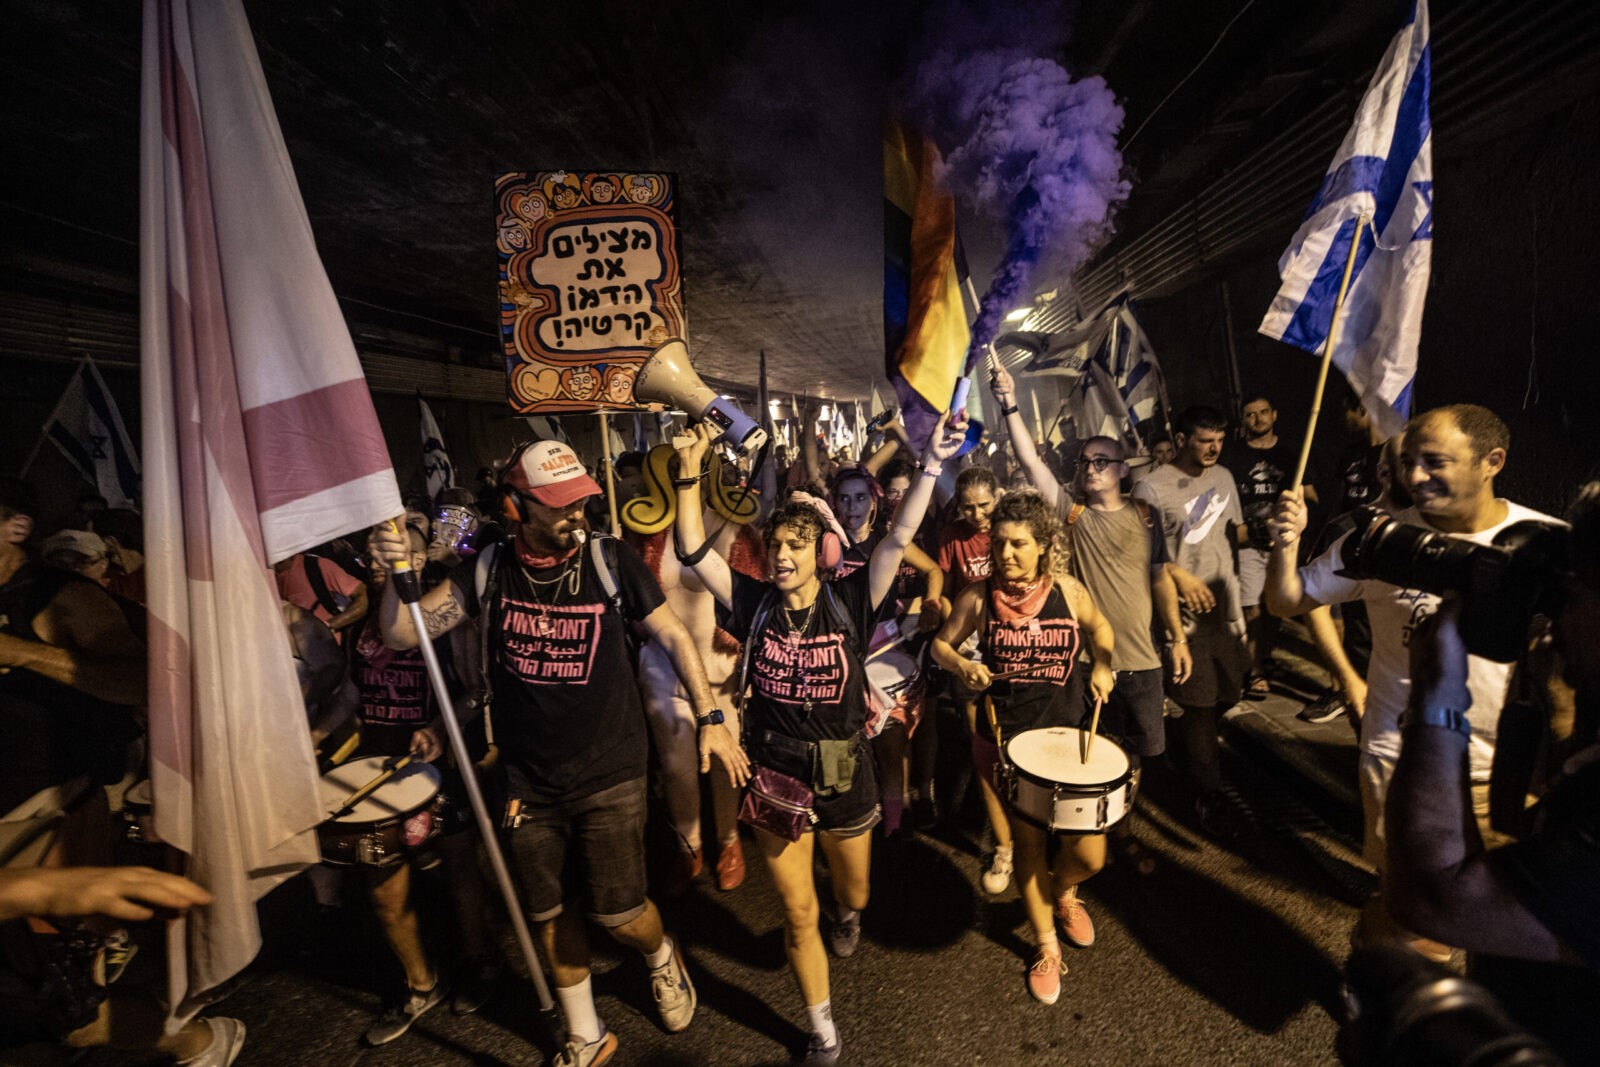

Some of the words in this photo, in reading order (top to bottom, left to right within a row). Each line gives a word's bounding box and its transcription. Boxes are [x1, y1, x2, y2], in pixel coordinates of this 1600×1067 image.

[552, 226, 652, 259] מצילים
[577, 257, 626, 281] את
[552, 312, 652, 348] קרטיה!
[541, 662, 584, 678] החזית
